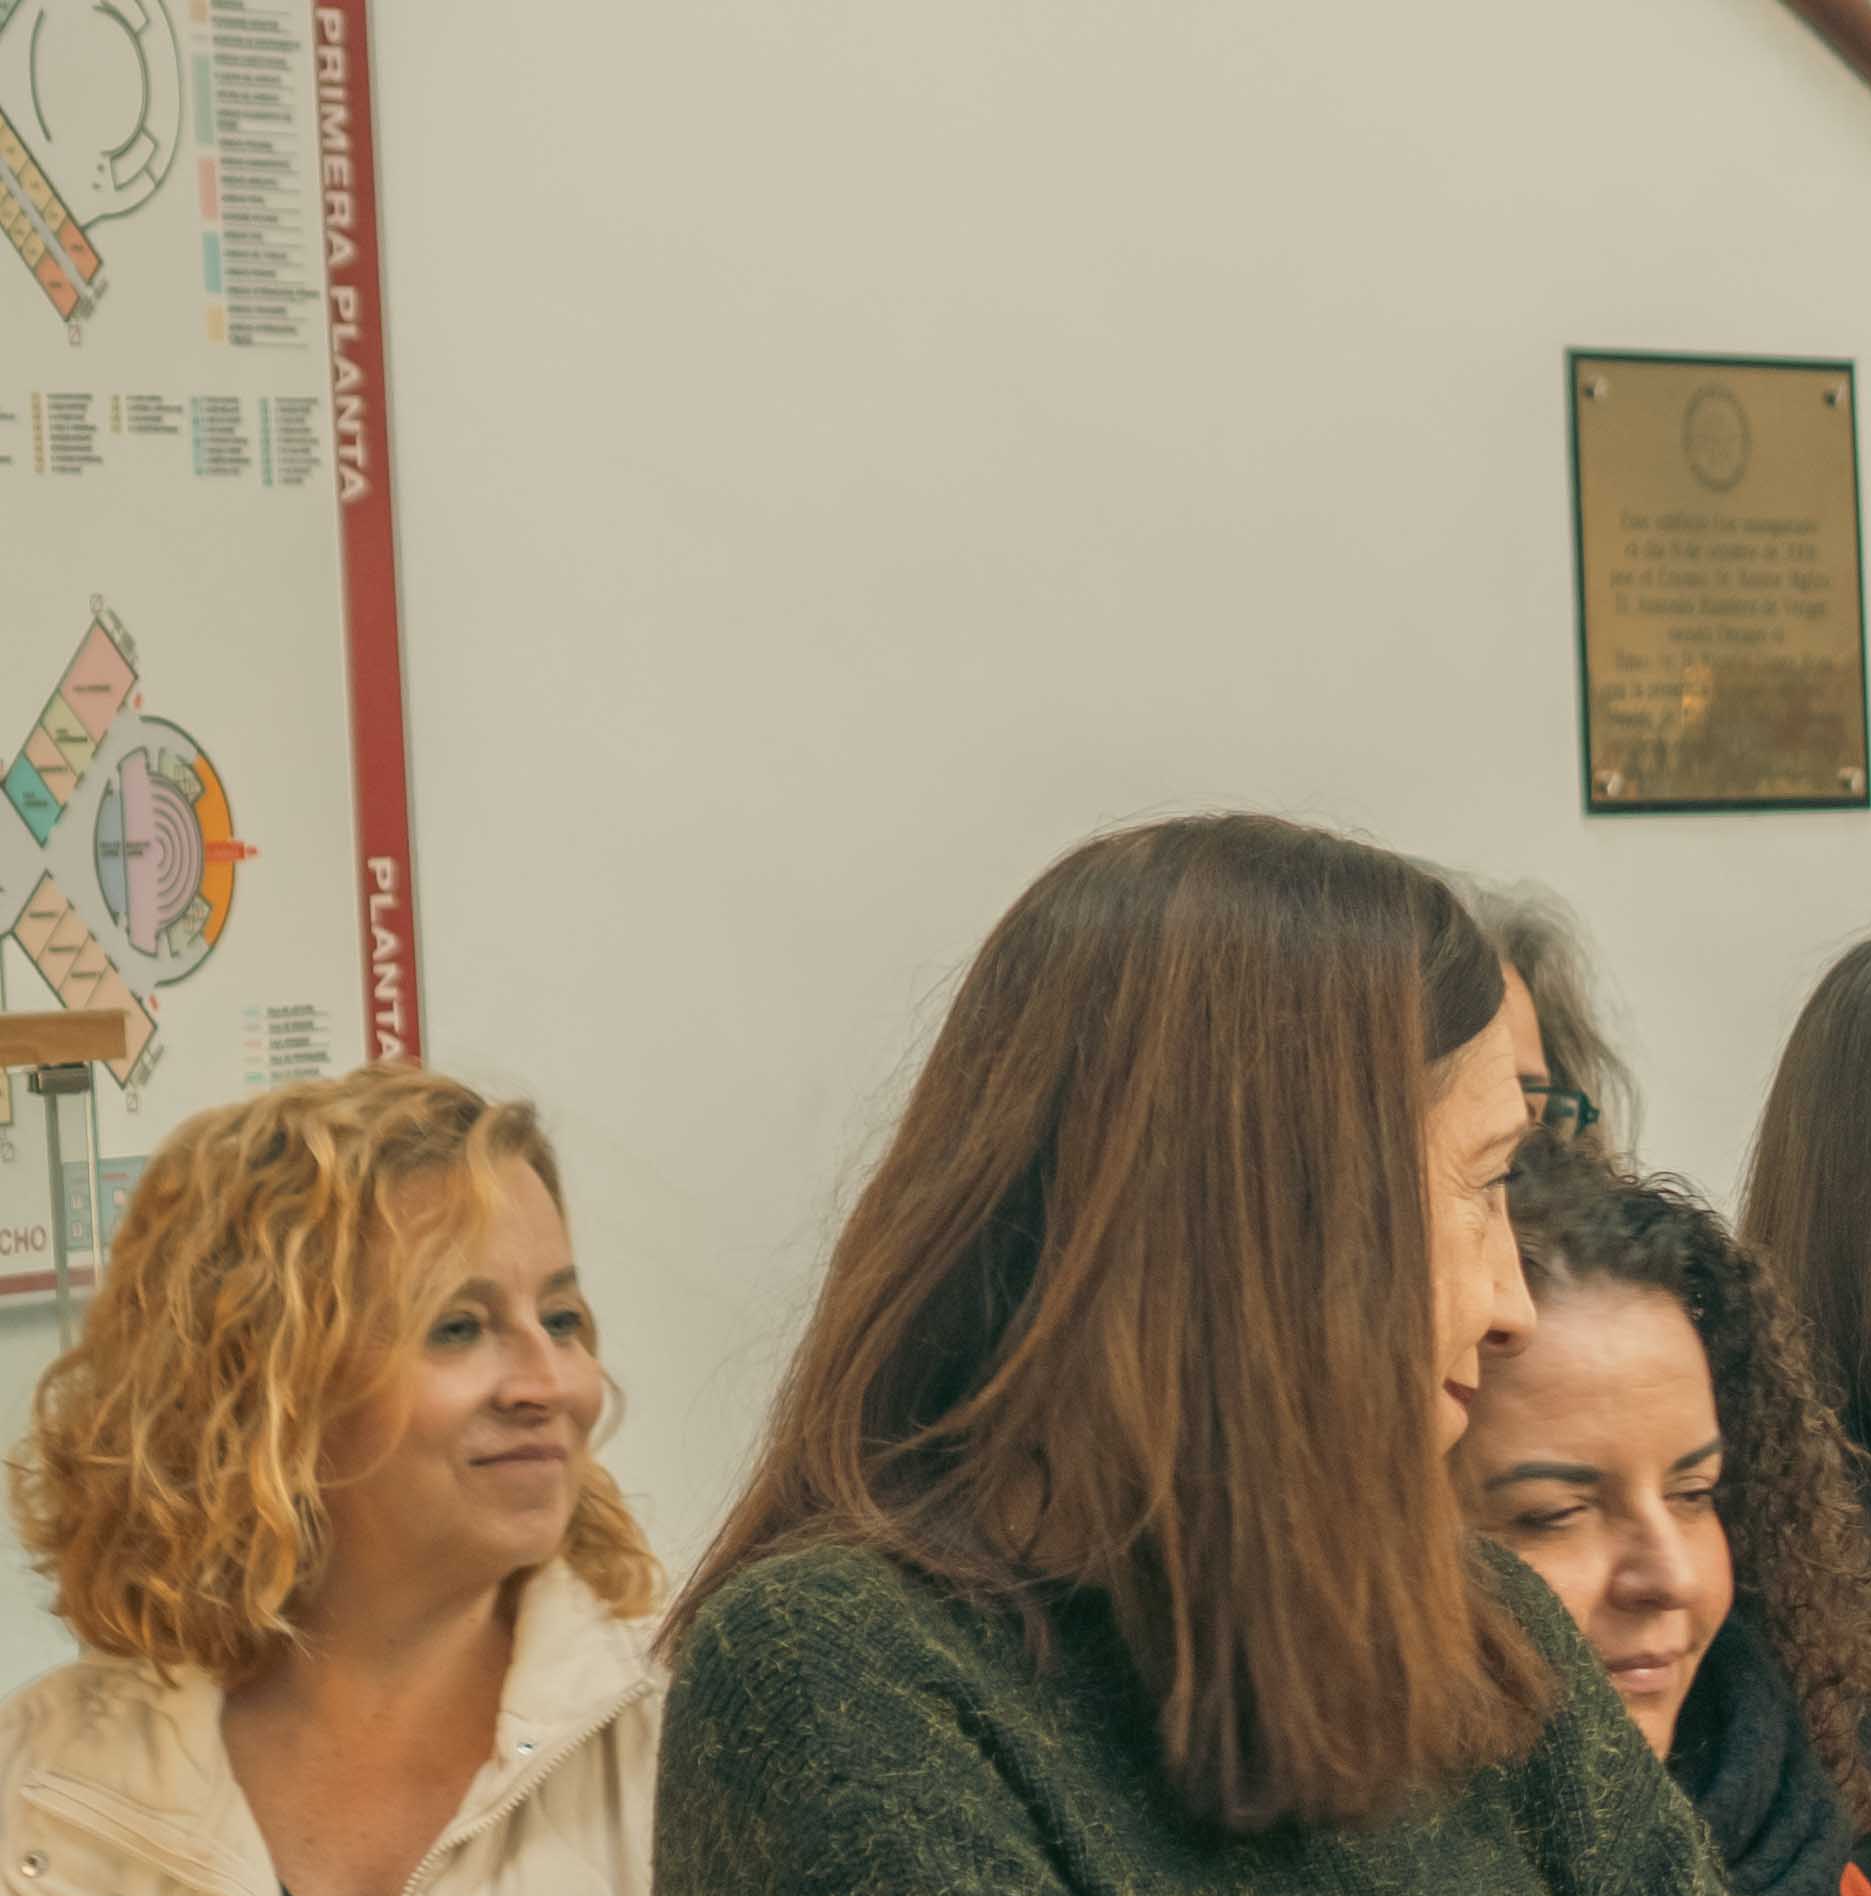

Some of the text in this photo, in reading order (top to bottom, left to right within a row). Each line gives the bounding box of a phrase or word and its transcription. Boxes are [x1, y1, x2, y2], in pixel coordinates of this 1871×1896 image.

[317, 7, 369, 501] PRIMERA PLANTA
[367, 856, 404, 1058] PLANTA
